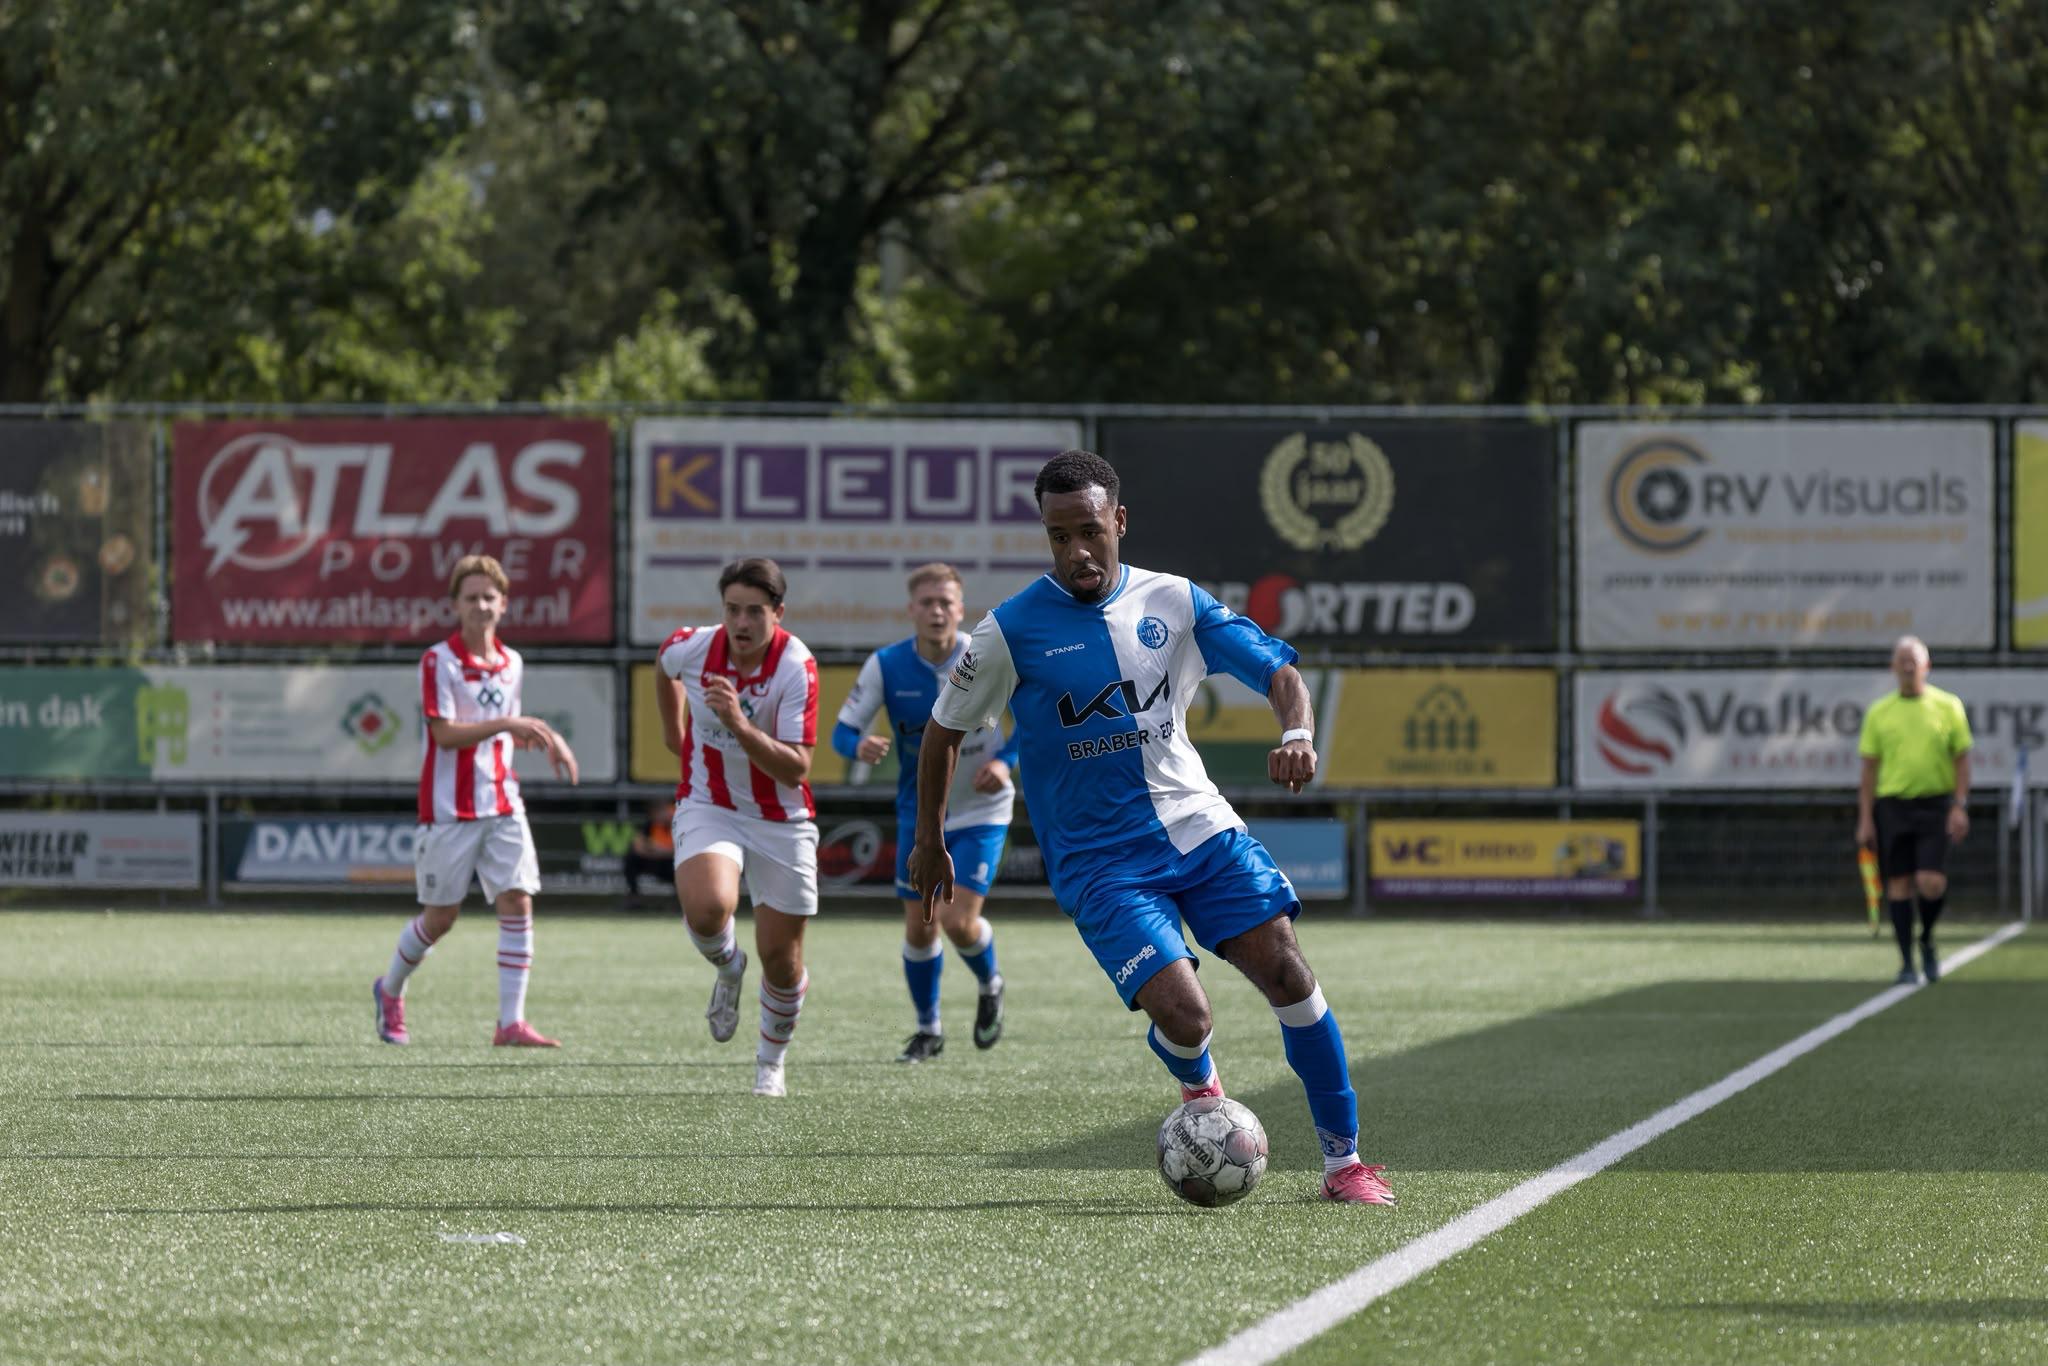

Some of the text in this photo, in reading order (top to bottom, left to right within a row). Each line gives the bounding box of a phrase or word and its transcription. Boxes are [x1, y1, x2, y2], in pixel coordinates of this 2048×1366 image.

[206, 439, 587, 545] ATLAS
[656, 454, 1043, 513] KLEUR
[1781, 467, 1968, 515] Visuals
[319, 539, 587, 582] POWER
[222, 588, 571, 635] www.atlaspor.nl
[1205, 581, 1476, 638] PORTTED
[1044, 643, 1086, 657] STANNO
[39, 694, 104, 728] dak
[1067, 729, 1151, 761] BRABER
[1173, 1122, 1215, 1169] DERBYSTAR
